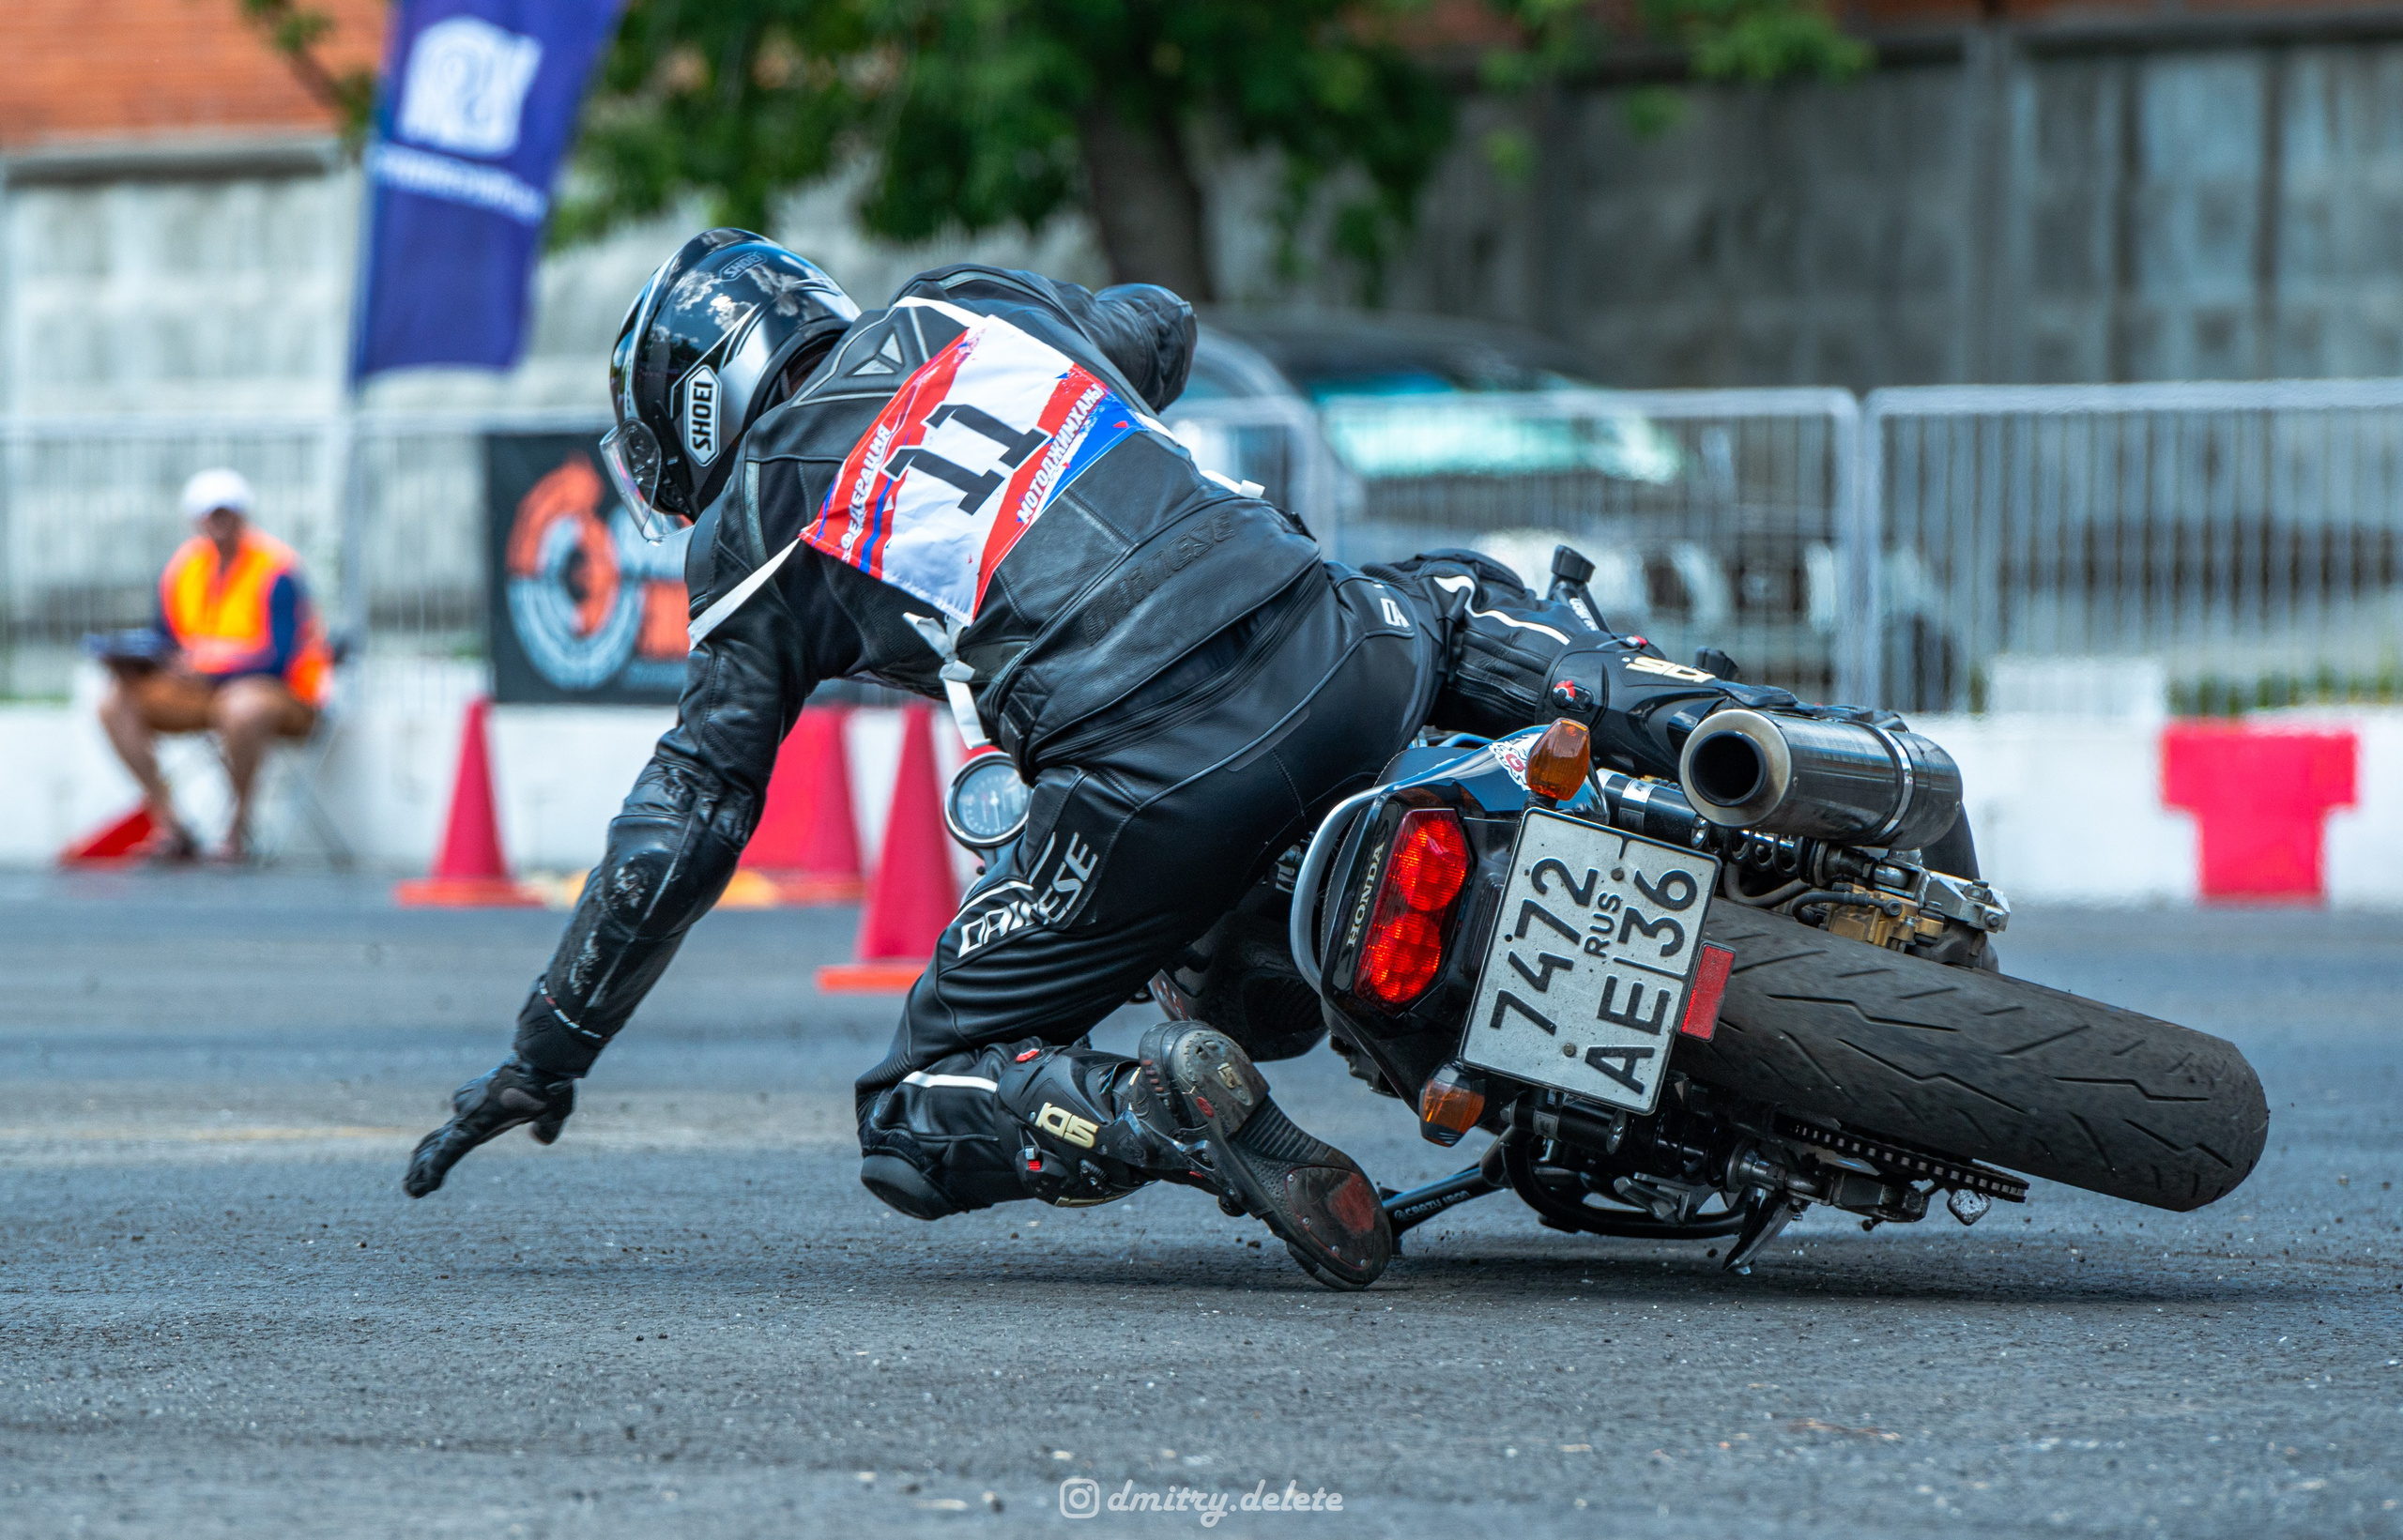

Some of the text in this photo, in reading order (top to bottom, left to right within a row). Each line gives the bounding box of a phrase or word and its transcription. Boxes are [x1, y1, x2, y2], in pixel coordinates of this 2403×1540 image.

[724, 252, 763, 278] SHOEI
[692, 381, 713, 451] SHOEI
[884, 404, 1049, 516] 11
[1017, 383, 1105, 525] МОТОДЖИМХАНЫ
[840, 423, 892, 551] ФЕДЕРАЦИЯ
[1346, 841, 1385, 948] HONDA
[1489, 857, 1599, 1037] 7472
[1583, 892, 1622, 958] RUS
[1584, 868, 1698, 1096] AE 36
